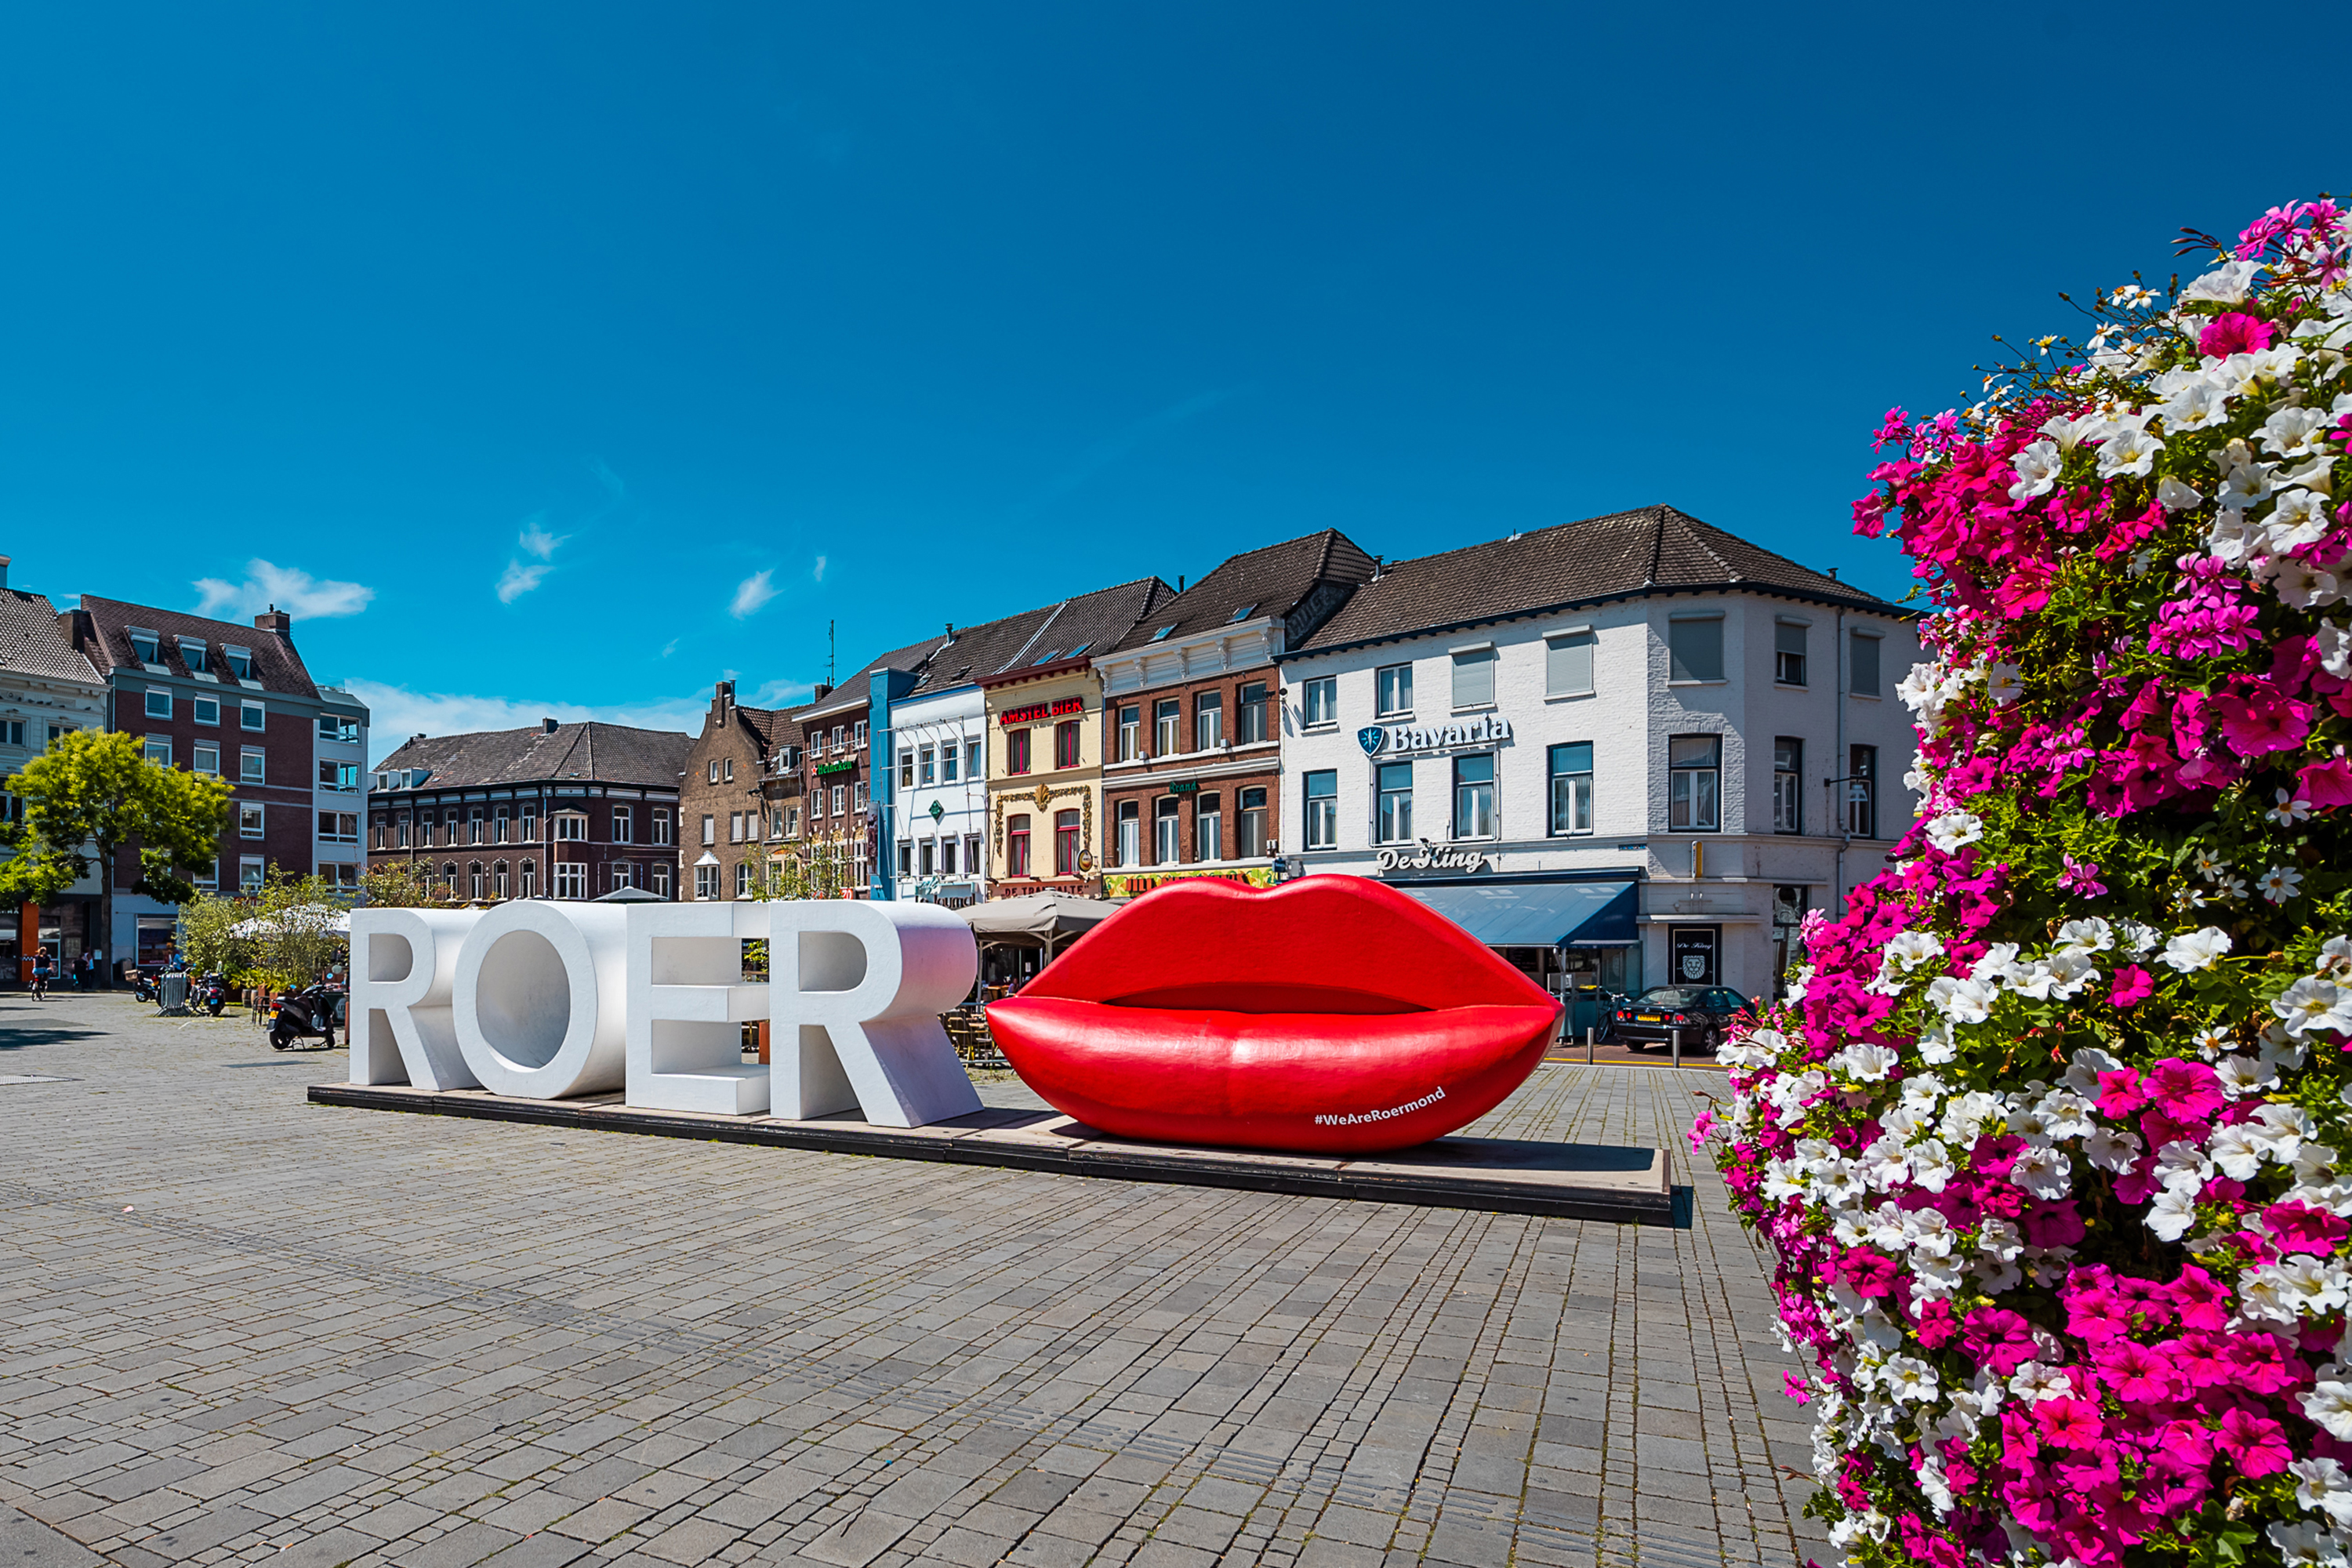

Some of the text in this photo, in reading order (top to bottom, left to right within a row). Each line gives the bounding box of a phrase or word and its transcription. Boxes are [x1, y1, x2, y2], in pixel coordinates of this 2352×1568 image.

[1000, 696, 1083, 725] AMSTEL BIER
[1383, 713, 1510, 753] Bavaria
[818, 760, 852, 775] Heineken
[1169, 780, 1196, 794] Brand
[1377, 846, 1484, 873] De King
[349, 900, 984, 1128] ROER
[1314, 1086, 1446, 1125] #WeAreRoermond
